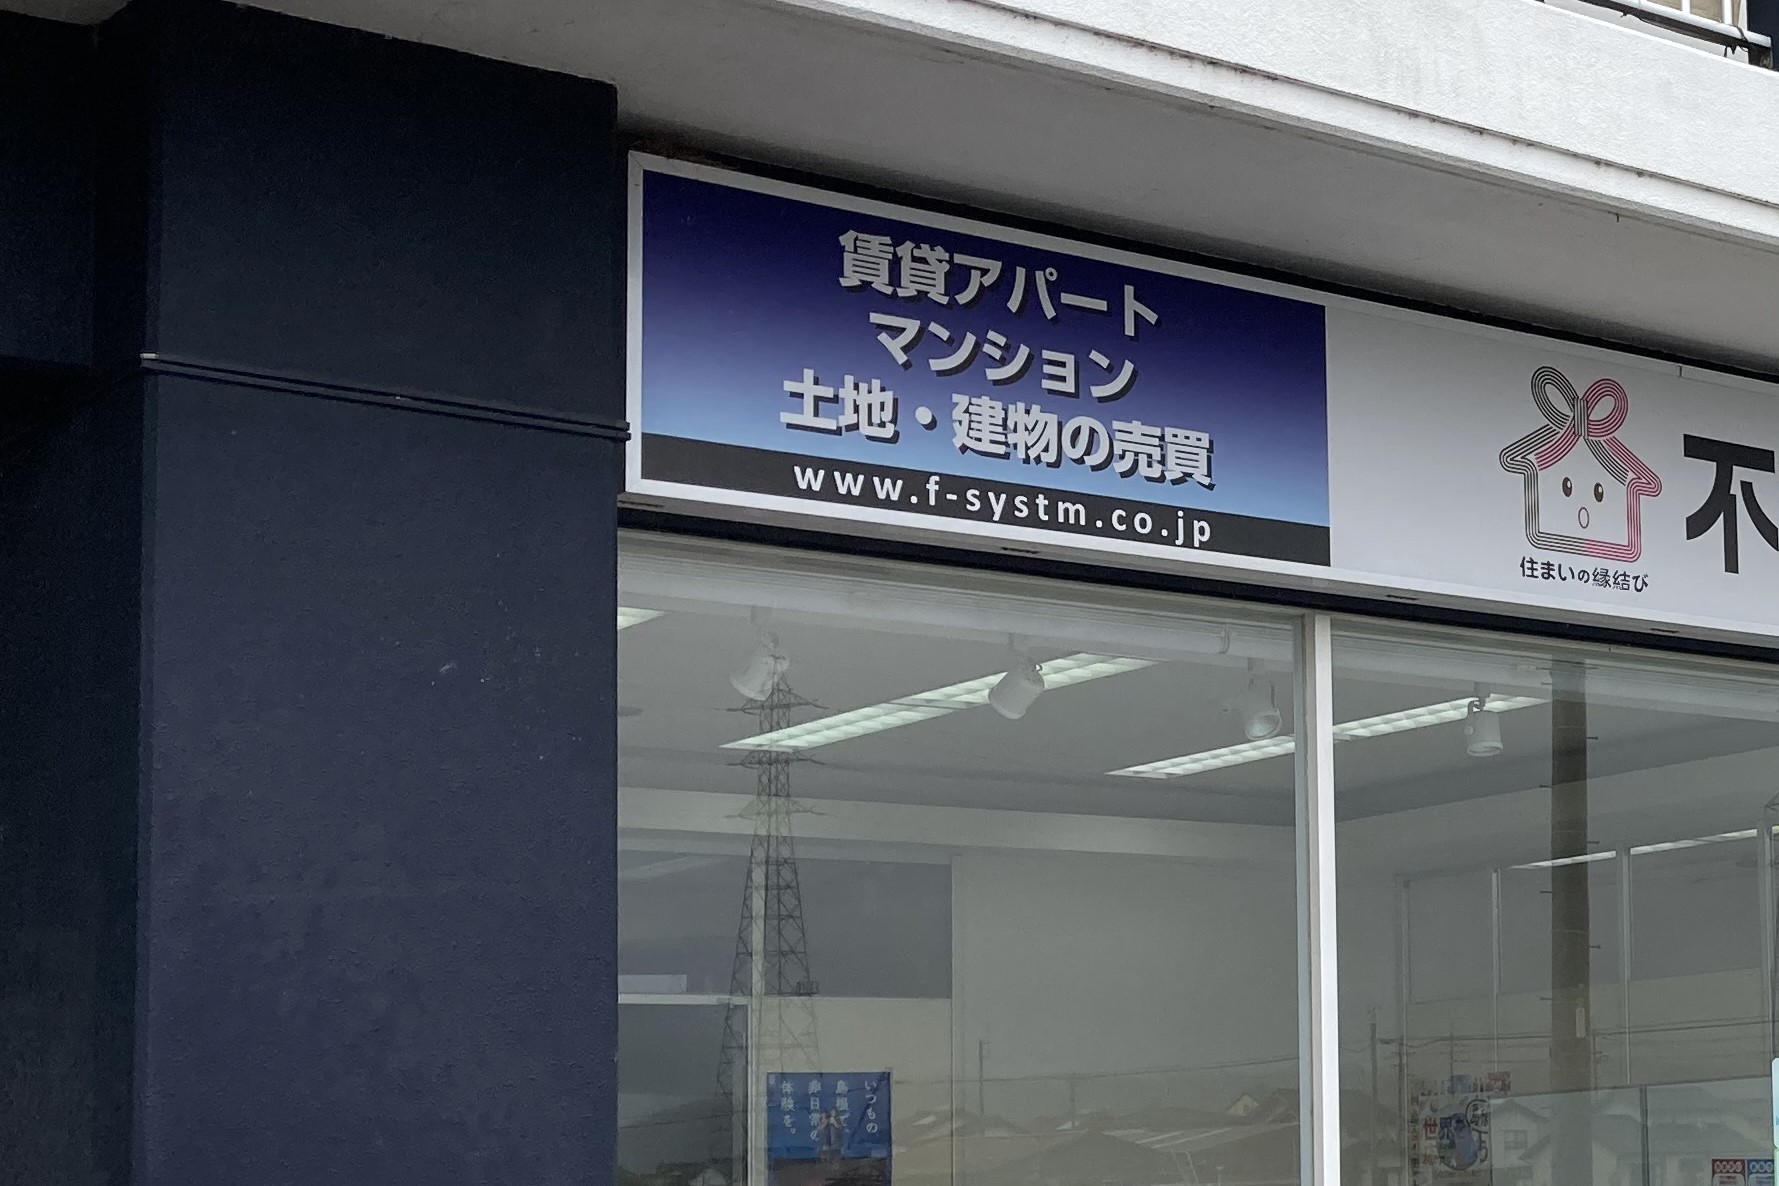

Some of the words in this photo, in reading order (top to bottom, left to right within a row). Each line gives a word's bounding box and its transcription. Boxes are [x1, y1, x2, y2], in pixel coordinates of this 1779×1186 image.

[839, 229, 1159, 338] 賃貸アパート
[869, 311, 1136, 400] マンション
[780, 367, 1215, 488] 土地・建物の売買
[793, 462, 1212, 548] www.f-systm.co.jp
[1520, 556, 1649, 592] 住まいの縁結び
